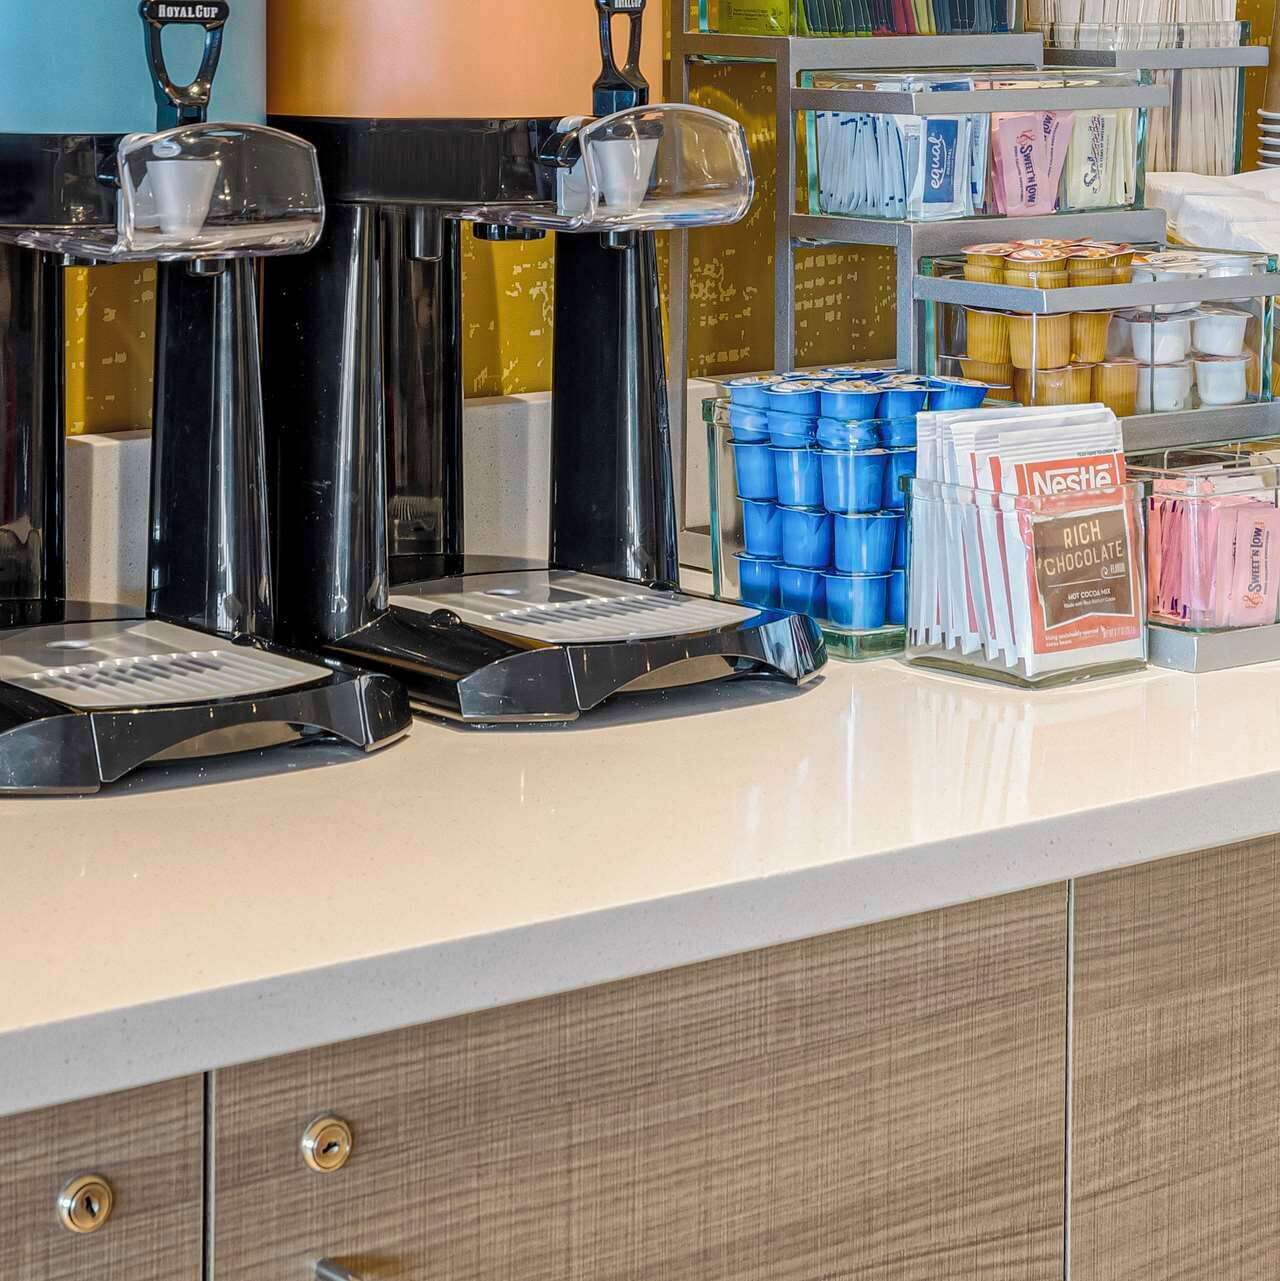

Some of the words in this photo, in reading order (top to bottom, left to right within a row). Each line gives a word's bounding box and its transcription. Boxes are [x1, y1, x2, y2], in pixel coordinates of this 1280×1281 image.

[928, 133, 944, 189] equal
[1025, 182, 1038, 203] LOW
[1063, 519, 1102, 549] RICH
[1250, 527, 1263, 549] LOW
[1044, 540, 1124, 576] CHOCOLATE
